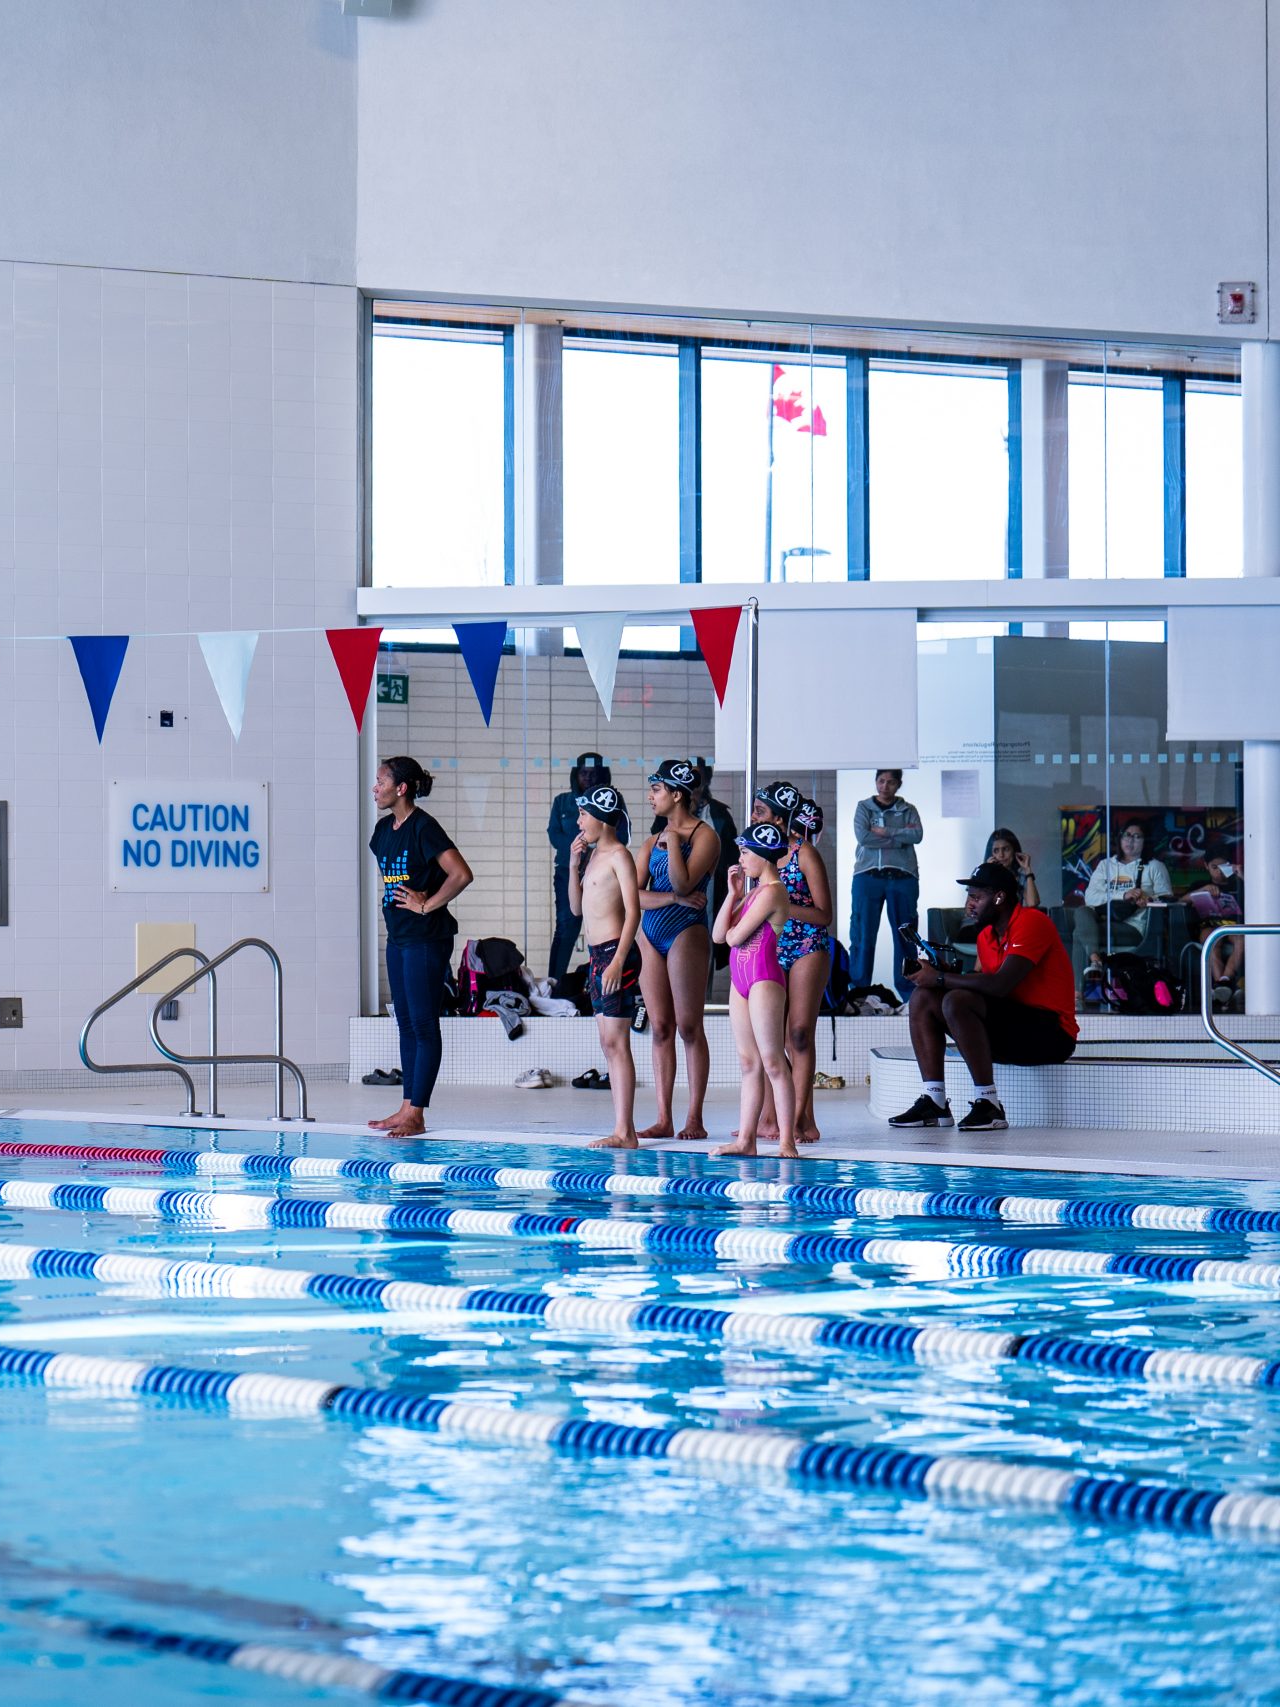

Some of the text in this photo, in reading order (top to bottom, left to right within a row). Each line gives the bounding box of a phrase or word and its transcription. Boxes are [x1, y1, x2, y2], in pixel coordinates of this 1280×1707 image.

[132, 803, 249, 832] CAUTION
[123, 839, 260, 868] NO DIVING
